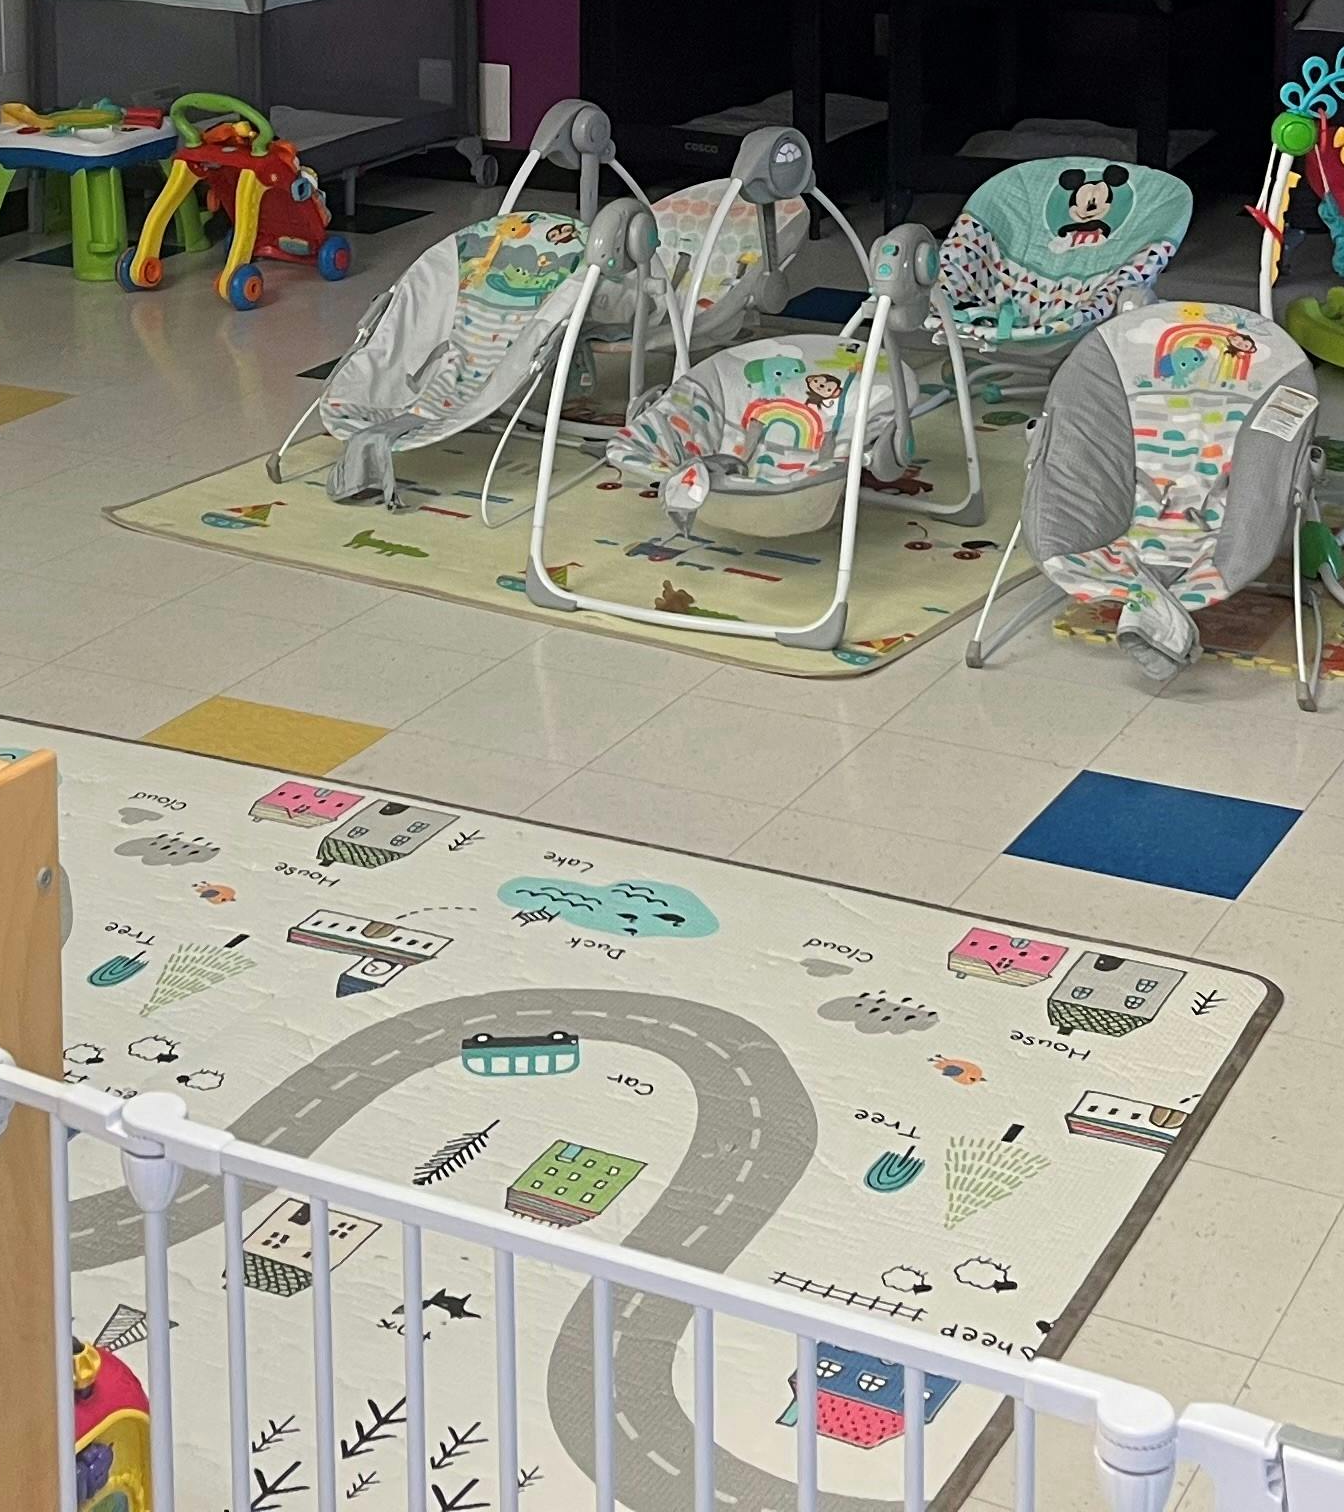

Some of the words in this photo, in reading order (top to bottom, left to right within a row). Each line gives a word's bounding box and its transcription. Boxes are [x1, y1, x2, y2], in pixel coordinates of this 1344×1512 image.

[128, 791, 187, 811] Cloud
[543, 850, 594, 873] Lake
[274, 861, 341, 888] House
[104, 921, 156, 946] Tree
[565, 936, 627, 960] Duck
[802, 938, 874, 963] Cloud
[1009, 1030, 1091, 1061] House
[607, 1073, 654, 1096] Car
[854, 1108, 921, 1140] Tree
